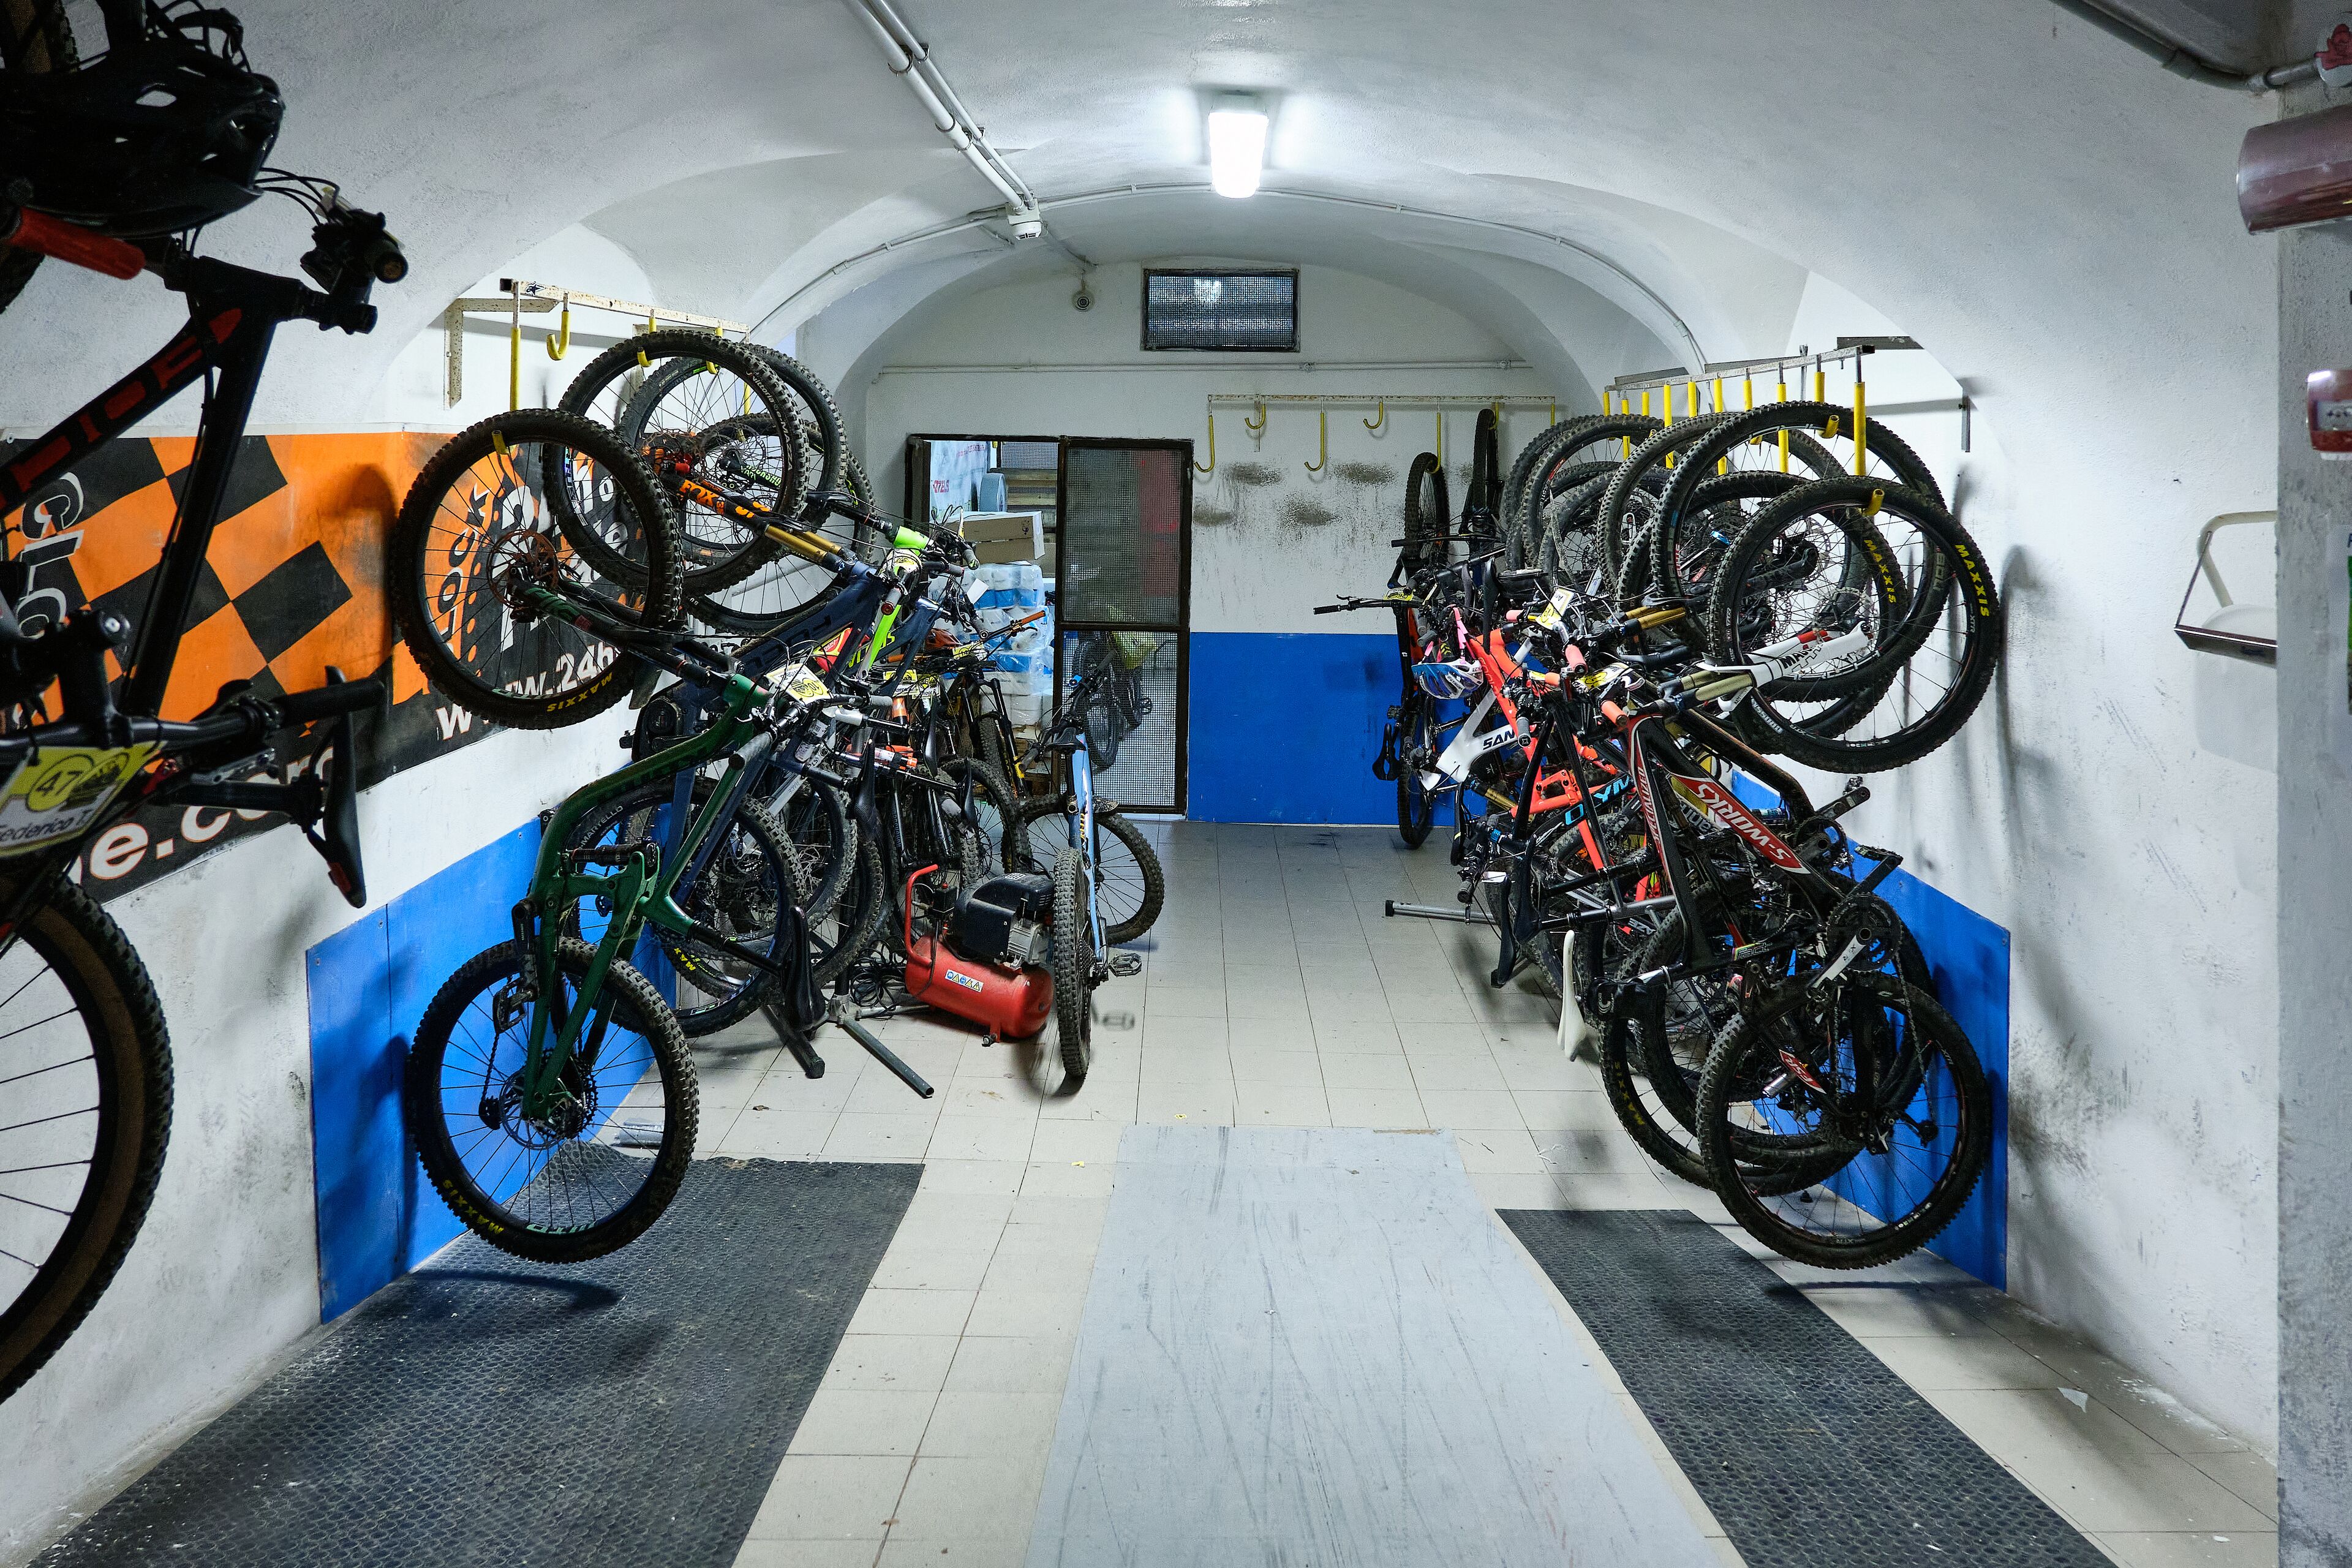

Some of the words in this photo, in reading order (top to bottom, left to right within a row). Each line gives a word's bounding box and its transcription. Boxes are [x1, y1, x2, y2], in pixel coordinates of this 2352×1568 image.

[679, 479, 719, 508] FOX
[745, 464, 783, 488] ROCKSHO
[436, 481, 493, 653] LOCK
[1864, 540, 1898, 605] MAXXIS
[1954, 544, 1991, 617] MAXXIS
[546, 672, 614, 712] MAXXIS
[809, 682, 820, 691] 10
[36, 770, 84, 797] 47
[1637, 766, 1662, 849] SPECIALIZED
[1696, 783, 1794, 860] S-WORKS
[1784, 1057, 1814, 1082] FSR
[442, 1179, 505, 1235] MAXXIS
